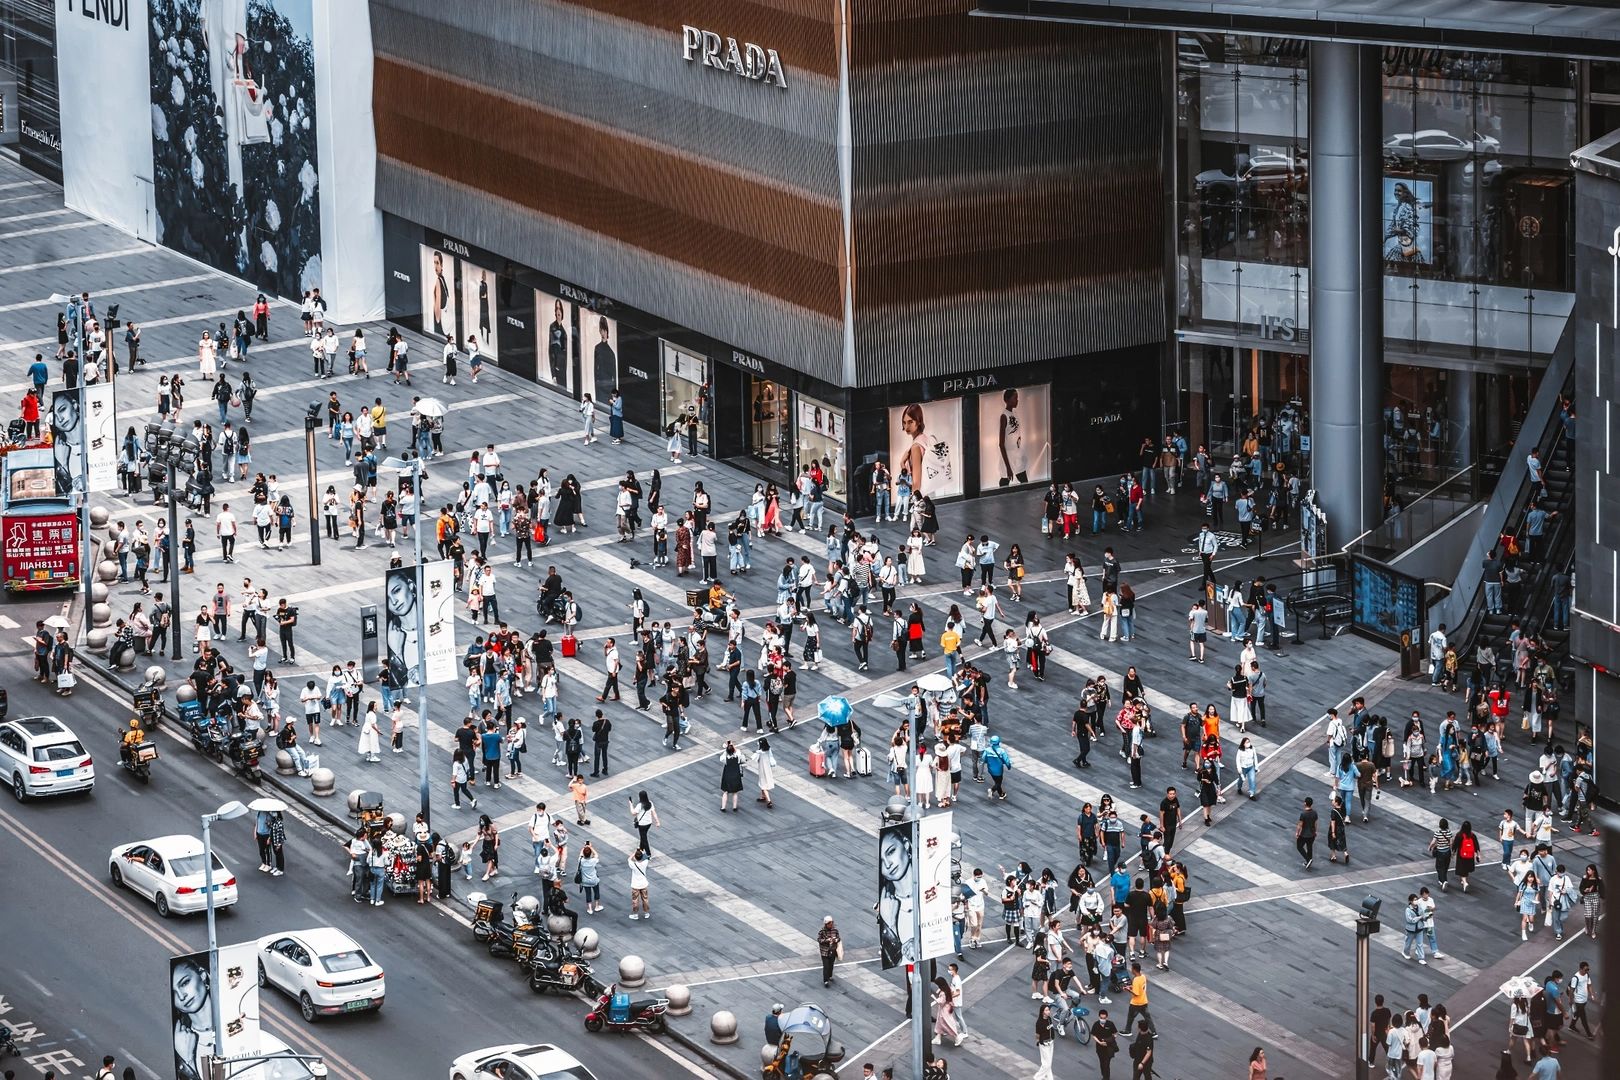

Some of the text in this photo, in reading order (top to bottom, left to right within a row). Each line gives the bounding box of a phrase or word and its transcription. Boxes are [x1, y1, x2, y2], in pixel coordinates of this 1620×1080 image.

[68, 0, 129, 31] NDI
[682, 24, 787, 88] PRADA
[443, 238, 470, 257] PRADA
[559, 283, 589, 304] PRADA
[1261, 315, 1294, 341] IFS
[732, 350, 765, 373] PRADA
[942, 374, 998, 393] PRADA
[1090, 413, 1122, 426] PRADA
[20, 560, 64, 570] 川AH8111
